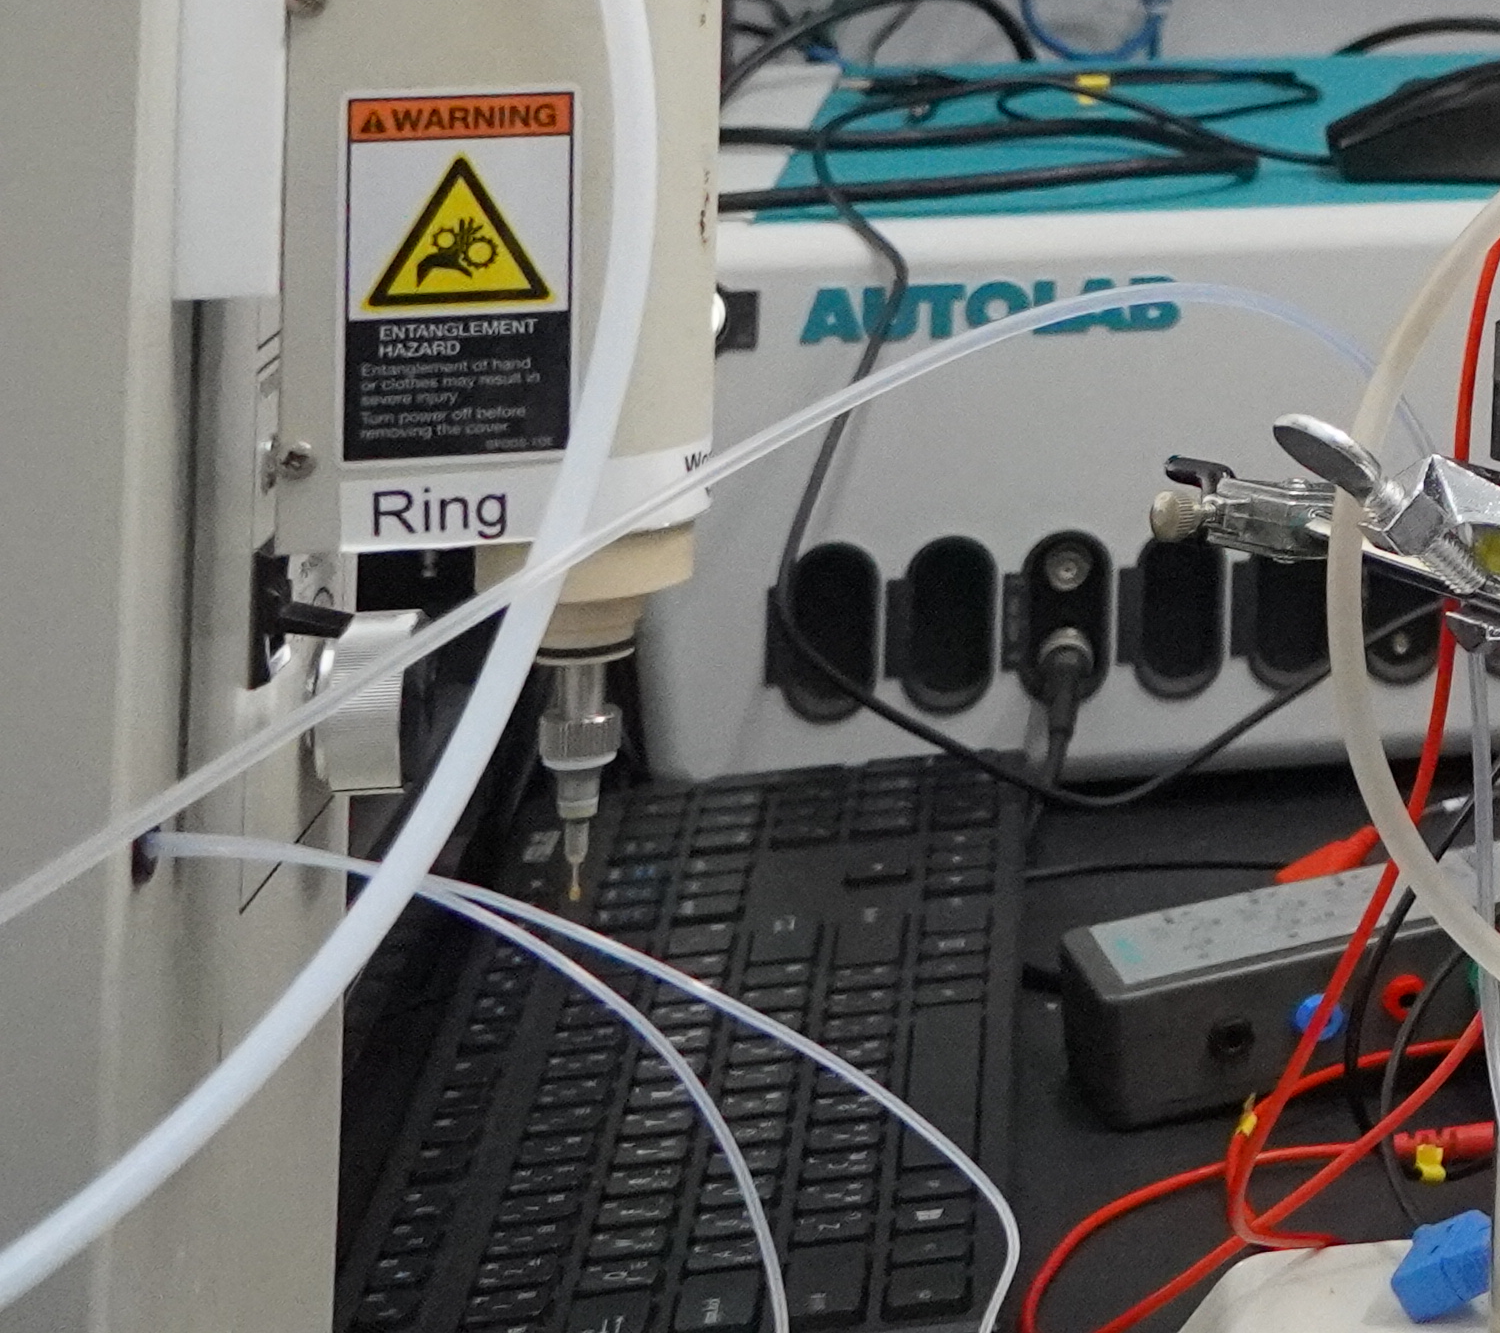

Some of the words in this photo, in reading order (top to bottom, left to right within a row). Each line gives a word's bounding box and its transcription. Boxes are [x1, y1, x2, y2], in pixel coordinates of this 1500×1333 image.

[391, 102, 557, 132] WARNING
[799, 275, 1182, 345] AUTOLAB
[378, 318, 539, 341] ENTANGLEMENT
[378, 340, 461, 358] HAZARD
[492, 356, 532, 371] hand
[360, 380, 378, 392] or
[443, 375, 475, 390] may
[416, 391, 459, 406] injury
[360, 411, 395, 424] Turn
[399, 410, 447, 425] power
[451, 406, 473, 420] off
[475, 405, 526, 419] before
[359, 424, 433, 440] removing
[436, 423, 461, 436] the
[373, 487, 507, 540] Ring
